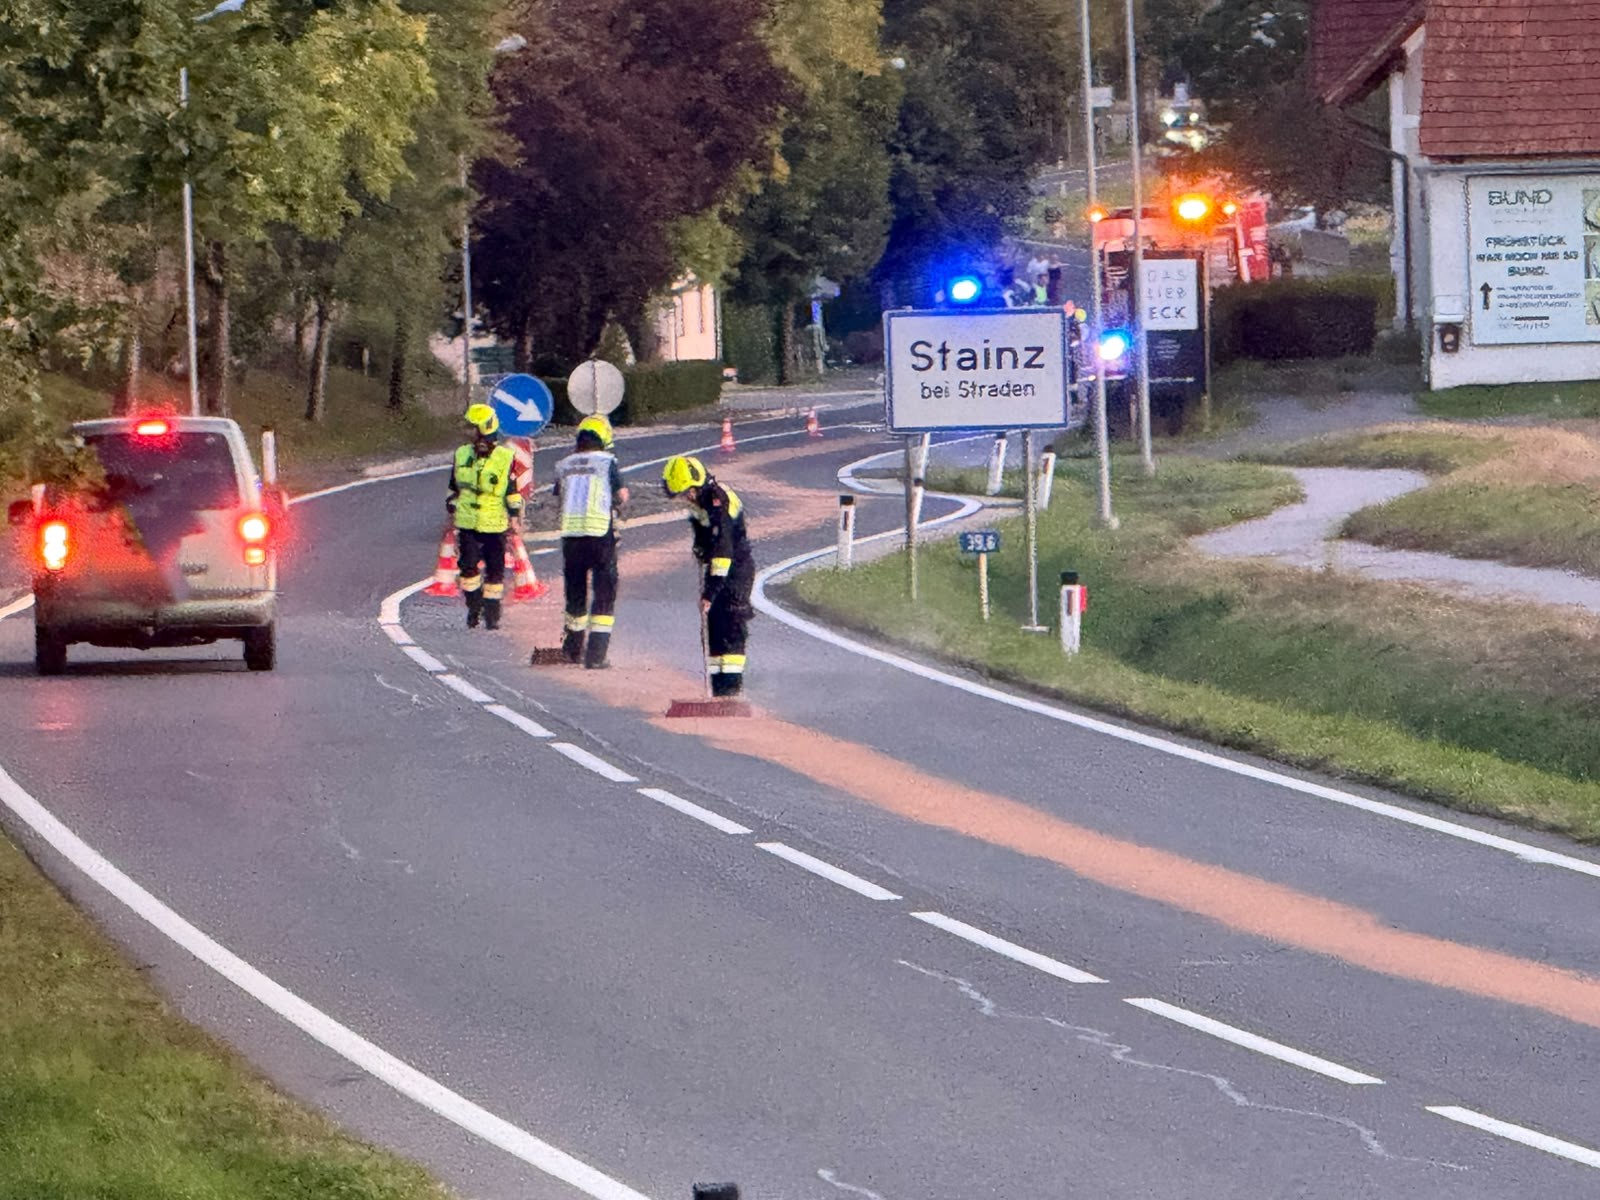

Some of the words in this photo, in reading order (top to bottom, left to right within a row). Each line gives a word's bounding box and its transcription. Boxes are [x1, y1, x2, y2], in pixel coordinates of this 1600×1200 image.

[1488, 189, 1552, 206] BUND
[1148, 305, 1187, 320] ECK
[910, 339, 1045, 371] Stainz
[921, 381, 950, 399] bei
[958, 380, 1035, 399] Straden
